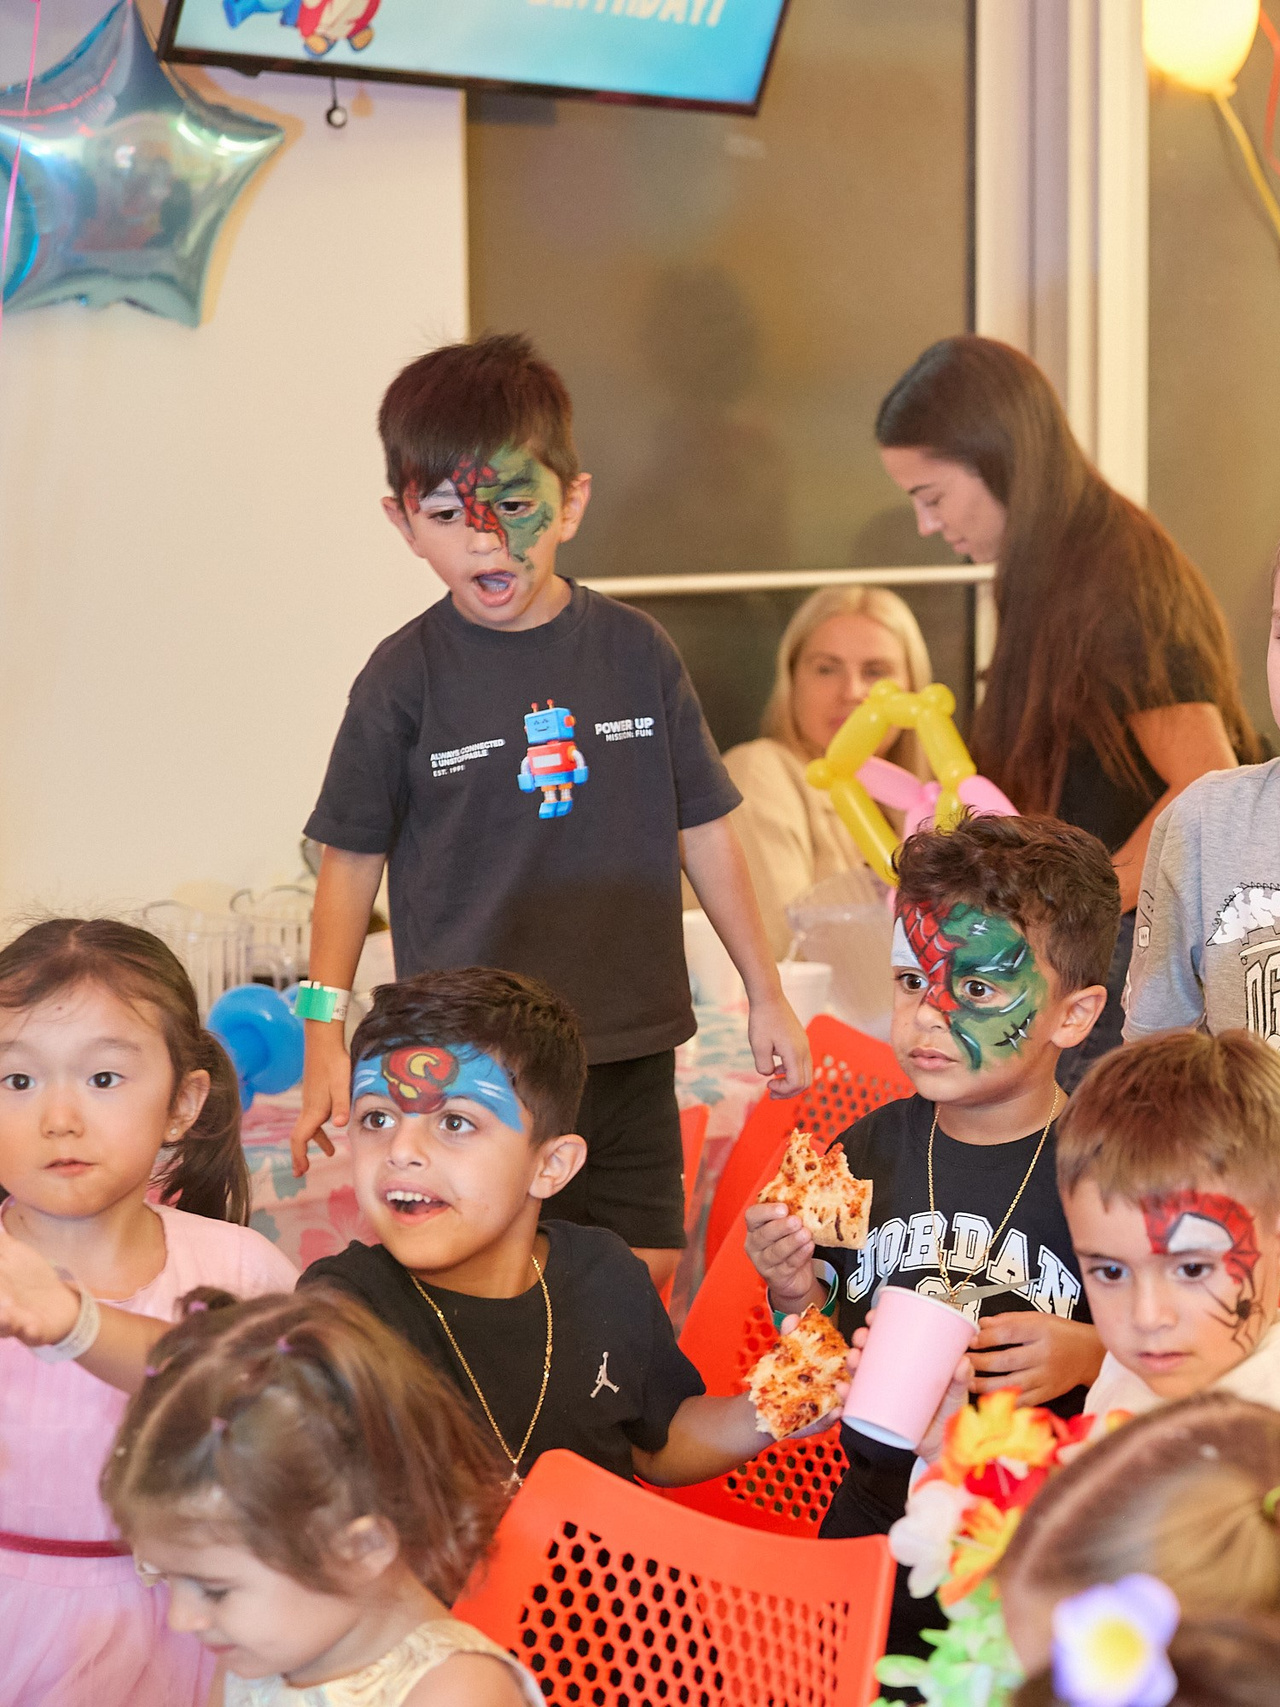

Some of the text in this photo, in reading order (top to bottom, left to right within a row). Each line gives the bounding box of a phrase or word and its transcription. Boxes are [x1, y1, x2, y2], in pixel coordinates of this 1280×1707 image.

[595, 717, 655, 735] POWER UP
[430, 739, 506, 761] ALWAYS CONNECTED
[438, 749, 489, 767] UNSTOPPABLE
[847, 1211, 1081, 1320] JORDAN
